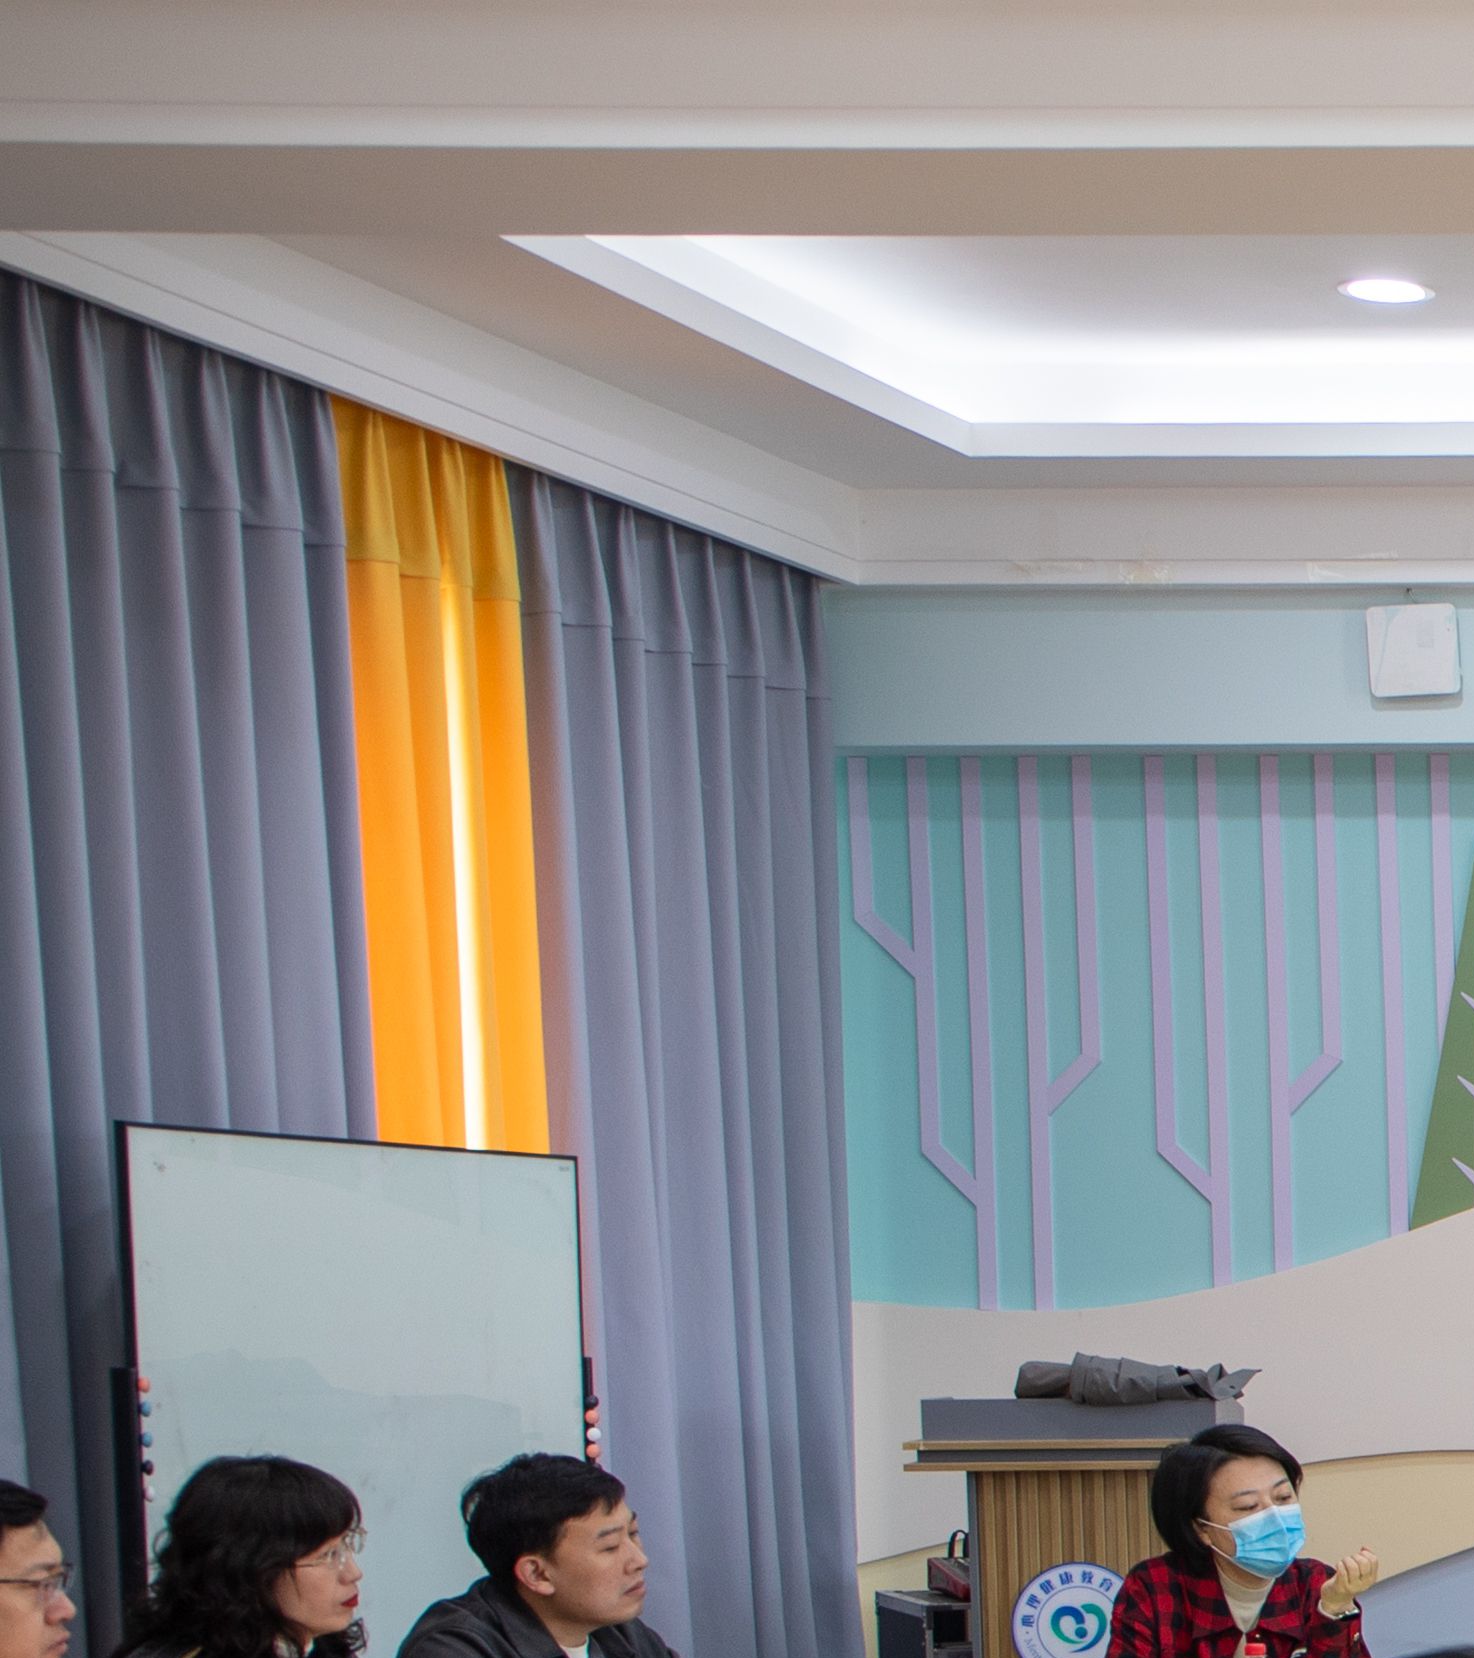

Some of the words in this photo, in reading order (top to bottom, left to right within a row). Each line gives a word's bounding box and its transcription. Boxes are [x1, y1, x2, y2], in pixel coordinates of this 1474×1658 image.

[1021, 1571, 1113, 1628] 心理健康教育
